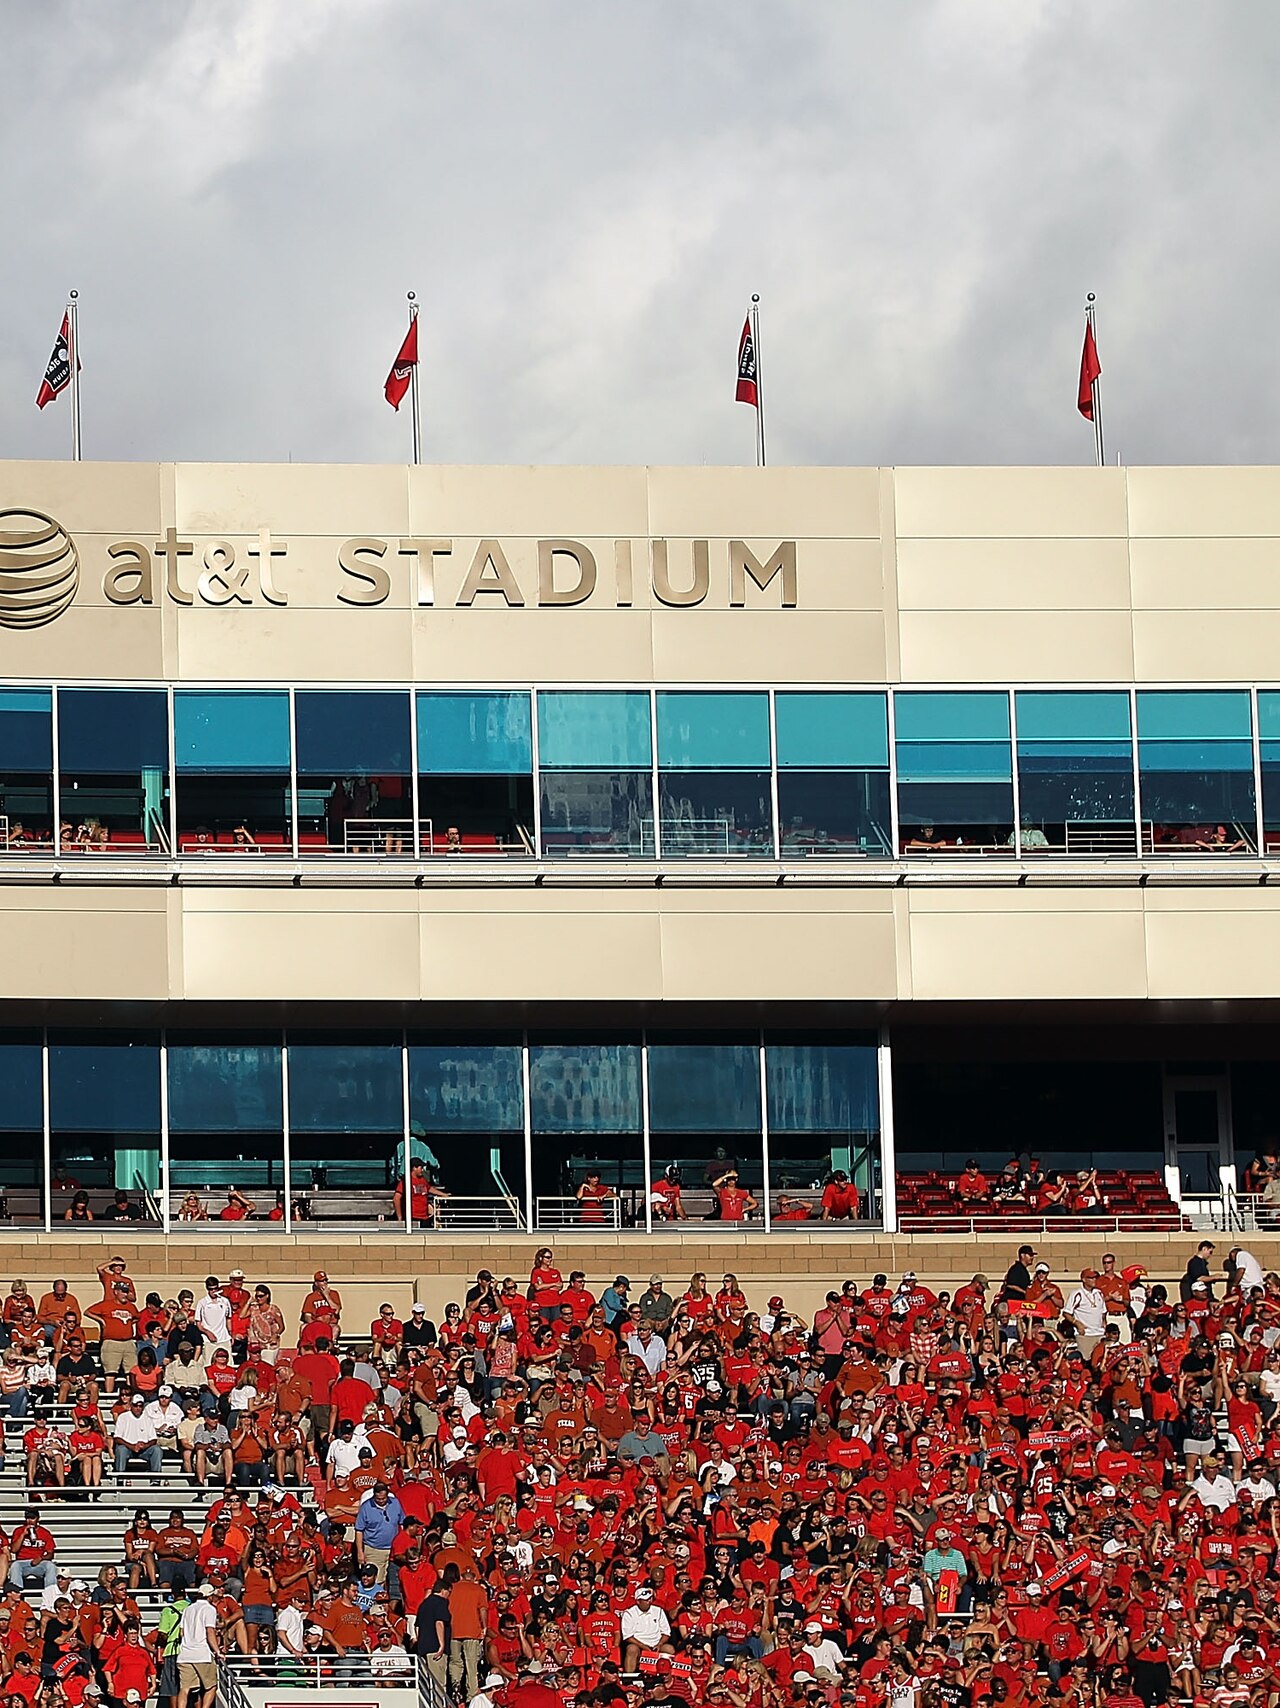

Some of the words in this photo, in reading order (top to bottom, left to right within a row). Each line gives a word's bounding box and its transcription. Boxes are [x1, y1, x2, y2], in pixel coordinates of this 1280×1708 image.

[101, 526, 289, 607] at&t
[336, 538, 798, 609] STADIUM
[685, 1395, 693, 1409] 6
[354, 1476, 377, 1488] TEXAS
[1037, 1477, 1052, 1494] 25
[671, 1662, 691, 1671] POWER
